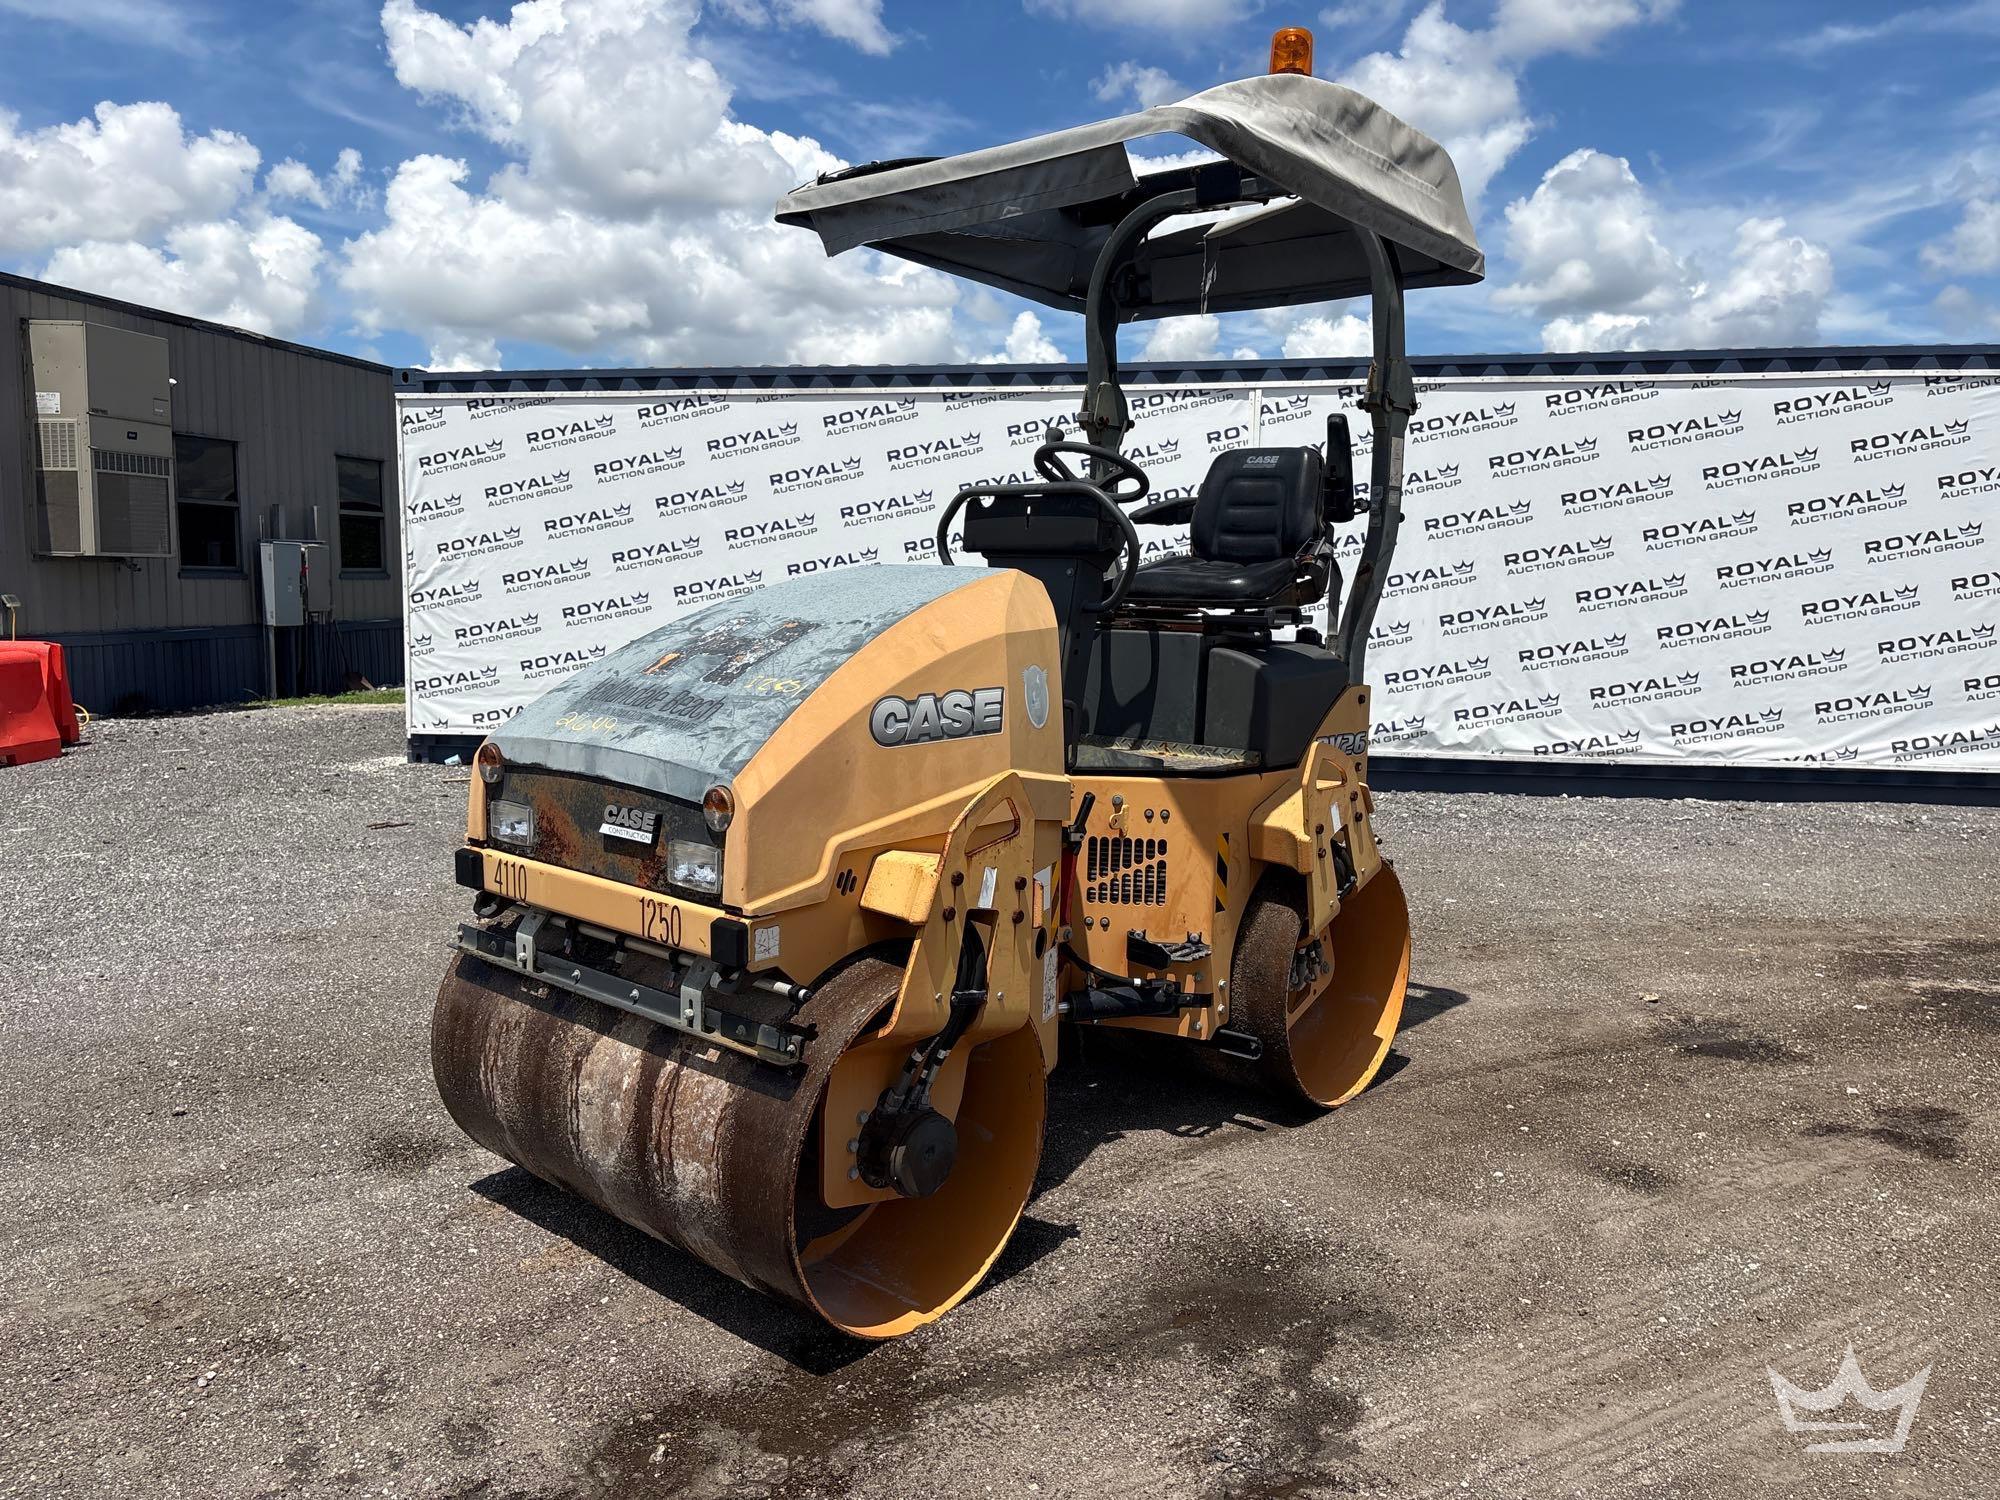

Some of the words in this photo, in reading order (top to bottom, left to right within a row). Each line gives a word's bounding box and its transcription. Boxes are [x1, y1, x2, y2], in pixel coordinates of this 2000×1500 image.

[1134, 403, 1188, 420] AUCTION
[1190, 393, 1234, 408] GROUP
[1546, 382, 1633, 408] ROYAL
[1549, 400, 1608, 417] AUCTION
[1611, 391, 1658, 405] GROUP
[1774, 388, 1866, 415] ROYAL
[638, 395, 708, 420] ROYAL
[641, 413, 689, 428] AUCTION
[692, 404, 730, 417] GROUP
[823, 404, 897, 428] ROYAL
[1777, 407, 1840, 425] AUCTION
[1844, 398, 1893, 412] GROUP
[526, 421, 596, 444] ROYAL
[827, 421, 876, 436] AUCTION
[879, 412, 918, 425] GROUP
[1409, 409, 1493, 434] ROYAL
[1412, 427, 1469, 444] AUCTION
[1472, 418, 1518, 432] GROUP
[1628, 417, 1718, 443] ROYAL
[530, 437, 576, 452] AUCTION
[579, 429, 616, 442] GROUP
[707, 428, 779, 452] ROYAL
[711, 446, 759, 460] AUCTION
[762, 437, 800, 450] GROUP
[887, 438, 962, 462] ROYAL
[1632, 436, 1692, 453] AUCTION
[1695, 426, 1744, 440] GROUP
[1851, 426, 1944, 453] ROYAL
[1854, 446, 1917, 463] AUCTION
[1921, 436, 1971, 450] GROUP
[419, 445, 486, 468] ROYAL
[423, 462, 467, 476] AUCTION
[470, 453, 506, 466] GROUP
[594, 452, 664, 475] ROYAL
[891, 456, 940, 471] AUCTION
[943, 447, 983, 460] GROUP
[1246, 455, 1280, 464] CASE
[1489, 444, 1574, 469] ROYAL
[1492, 462, 1550, 478] AUCTION
[1553, 453, 1599, 467] GROUP
[1703, 454, 1794, 480] ROYAL
[598, 469, 645, 484] AUCTION
[647, 461, 685, 473] GROUP
[770, 463, 842, 486] ROYAL
[774, 480, 822, 494] AUCTION
[825, 471, 864, 484] GROUP
[1706, 473, 1767, 490] AUCTION
[1771, 463, 1820, 478] GROUP
[485, 476, 552, 498] ROYAL
[488, 492, 534, 507] AUCTION
[536, 484, 572, 497] GROUP
[656, 486, 726, 509] ROYAL
[1561, 481, 1648, 506] ROYAL
[659, 503, 707, 518] AUCTION
[709, 495, 747, 507] GROUP
[840, 496, 914, 518] ROYAL
[1564, 500, 1623, 516] AUCTION
[1626, 490, 1673, 504] GROUP
[1788, 490, 1880, 516] ROYAL
[1791, 509, 1854, 526] AUCTION
[1857, 500, 1907, 514] GROUP
[544, 509, 613, 531] ROYAL
[844, 512, 893, 527] AUCTION
[896, 504, 935, 517] GROUP
[1424, 506, 1509, 531] ROYAL
[548, 526, 594, 540] AUCTION
[597, 518, 634, 530] GROUP
[725, 519, 796, 541] ROYAL
[729, 536, 776, 550] AUCTION
[779, 528, 817, 540] GROUP
[1428, 524, 1484, 541] AUCTION
[1488, 516, 1533, 529] GROUP
[1643, 517, 1732, 542] ROYAL
[1646, 535, 1706, 552] AUCTION
[1710, 526, 1758, 540] GROUP
[437, 532, 504, 554] ROYAL
[441, 548, 485, 562] AUCTION
[487, 540, 523, 552] GROUP
[612, 542, 682, 563] ROYAL
[1864, 528, 1958, 554] ROYAL
[1868, 548, 1930, 564] AUCTION
[1934, 538, 1984, 552] GROUP
[616, 558, 663, 572] AUCTION
[665, 550, 702, 562] GROUP
[1504, 542, 1590, 566] ROYAL
[1507, 560, 1565, 576] AUCTION
[1568, 552, 1614, 565] GROUP
[502, 564, 570, 585] ROYAL
[1717, 554, 1808, 580] ROYAL
[1720, 573, 1781, 589] AUCTION
[1785, 564, 1834, 578] GROUP
[506, 580, 552, 594] AUCTION
[554, 572, 590, 584] GROUP
[1576, 580, 1662, 603] ROYAL
[562, 597, 632, 618] ROYAL
[1579, 598, 1637, 613] AUCTION
[1640, 589, 1688, 602] GROUP
[1802, 591, 1894, 616] ROYAL
[566, 614, 612, 627] AUCTION
[615, 606, 652, 617] GROUP
[1440, 603, 1524, 627] ROYAL
[1443, 621, 1499, 636] AUCTION
[1503, 613, 1548, 626] GROUP
[1805, 610, 1867, 626] AUCTION
[1871, 601, 1920, 614] GROUP
[455, 618, 521, 639] ROYAL
[458, 634, 503, 648] AUCTION
[506, 627, 541, 638] GROUP
[1657, 616, 1746, 640] ROYAL
[1660, 634, 1720, 649] AUCTION
[1723, 626, 1771, 639] GROUP
[1519, 639, 1604, 662] ROYAL
[1878, 630, 1971, 654] ROYAL
[1881, 648, 1944, 664] AUCTION
[1948, 640, 1997, 653] GROUP
[520, 650, 588, 671] ROYAL
[1522, 657, 1579, 672] AUCTION
[1582, 649, 1628, 662] GROUP
[1730, 654, 1821, 678] ROYAL
[414, 671, 480, 691] ROYAL
[524, 666, 570, 680] AUCTION
[1384, 662, 1467, 685] ROYAL
[1388, 680, 1444, 694] AUCTION
[1447, 672, 1491, 684] GROUP
[1734, 672, 1794, 688] AUCTION
[1798, 664, 1847, 677] GROUP
[419, 686, 462, 698] AUCTION
[464, 679, 500, 690] GROUP
[581, 677, 669, 713] Hallandale
[659, 689, 728, 722] Beach
[1590, 677, 1676, 700] ROYAL
[1593, 695, 1651, 710] AUCTION
[1654, 687, 1701, 700] GROUP
[1454, 699, 1538, 722] ROYAL
[1815, 691, 1907, 714] ROYAL
[1818, 709, 1880, 724] AUCTION
[1884, 701, 1933, 714] GROUP
[871, 687, 1004, 746] CASE
[1458, 716, 1514, 730] AUCTION
[1517, 709, 1562, 721] GROUP
[1671, 714, 1759, 736] ROYAL
[1674, 732, 1733, 746] AUCTION
[1736, 724, 1784, 736] GROUP
[604, 804, 656, 832] CASE
[608, 826, 650, 841] CONSTRUCTION
[494, 858, 527, 901] 4110
[639, 896, 681, 948] 1250
